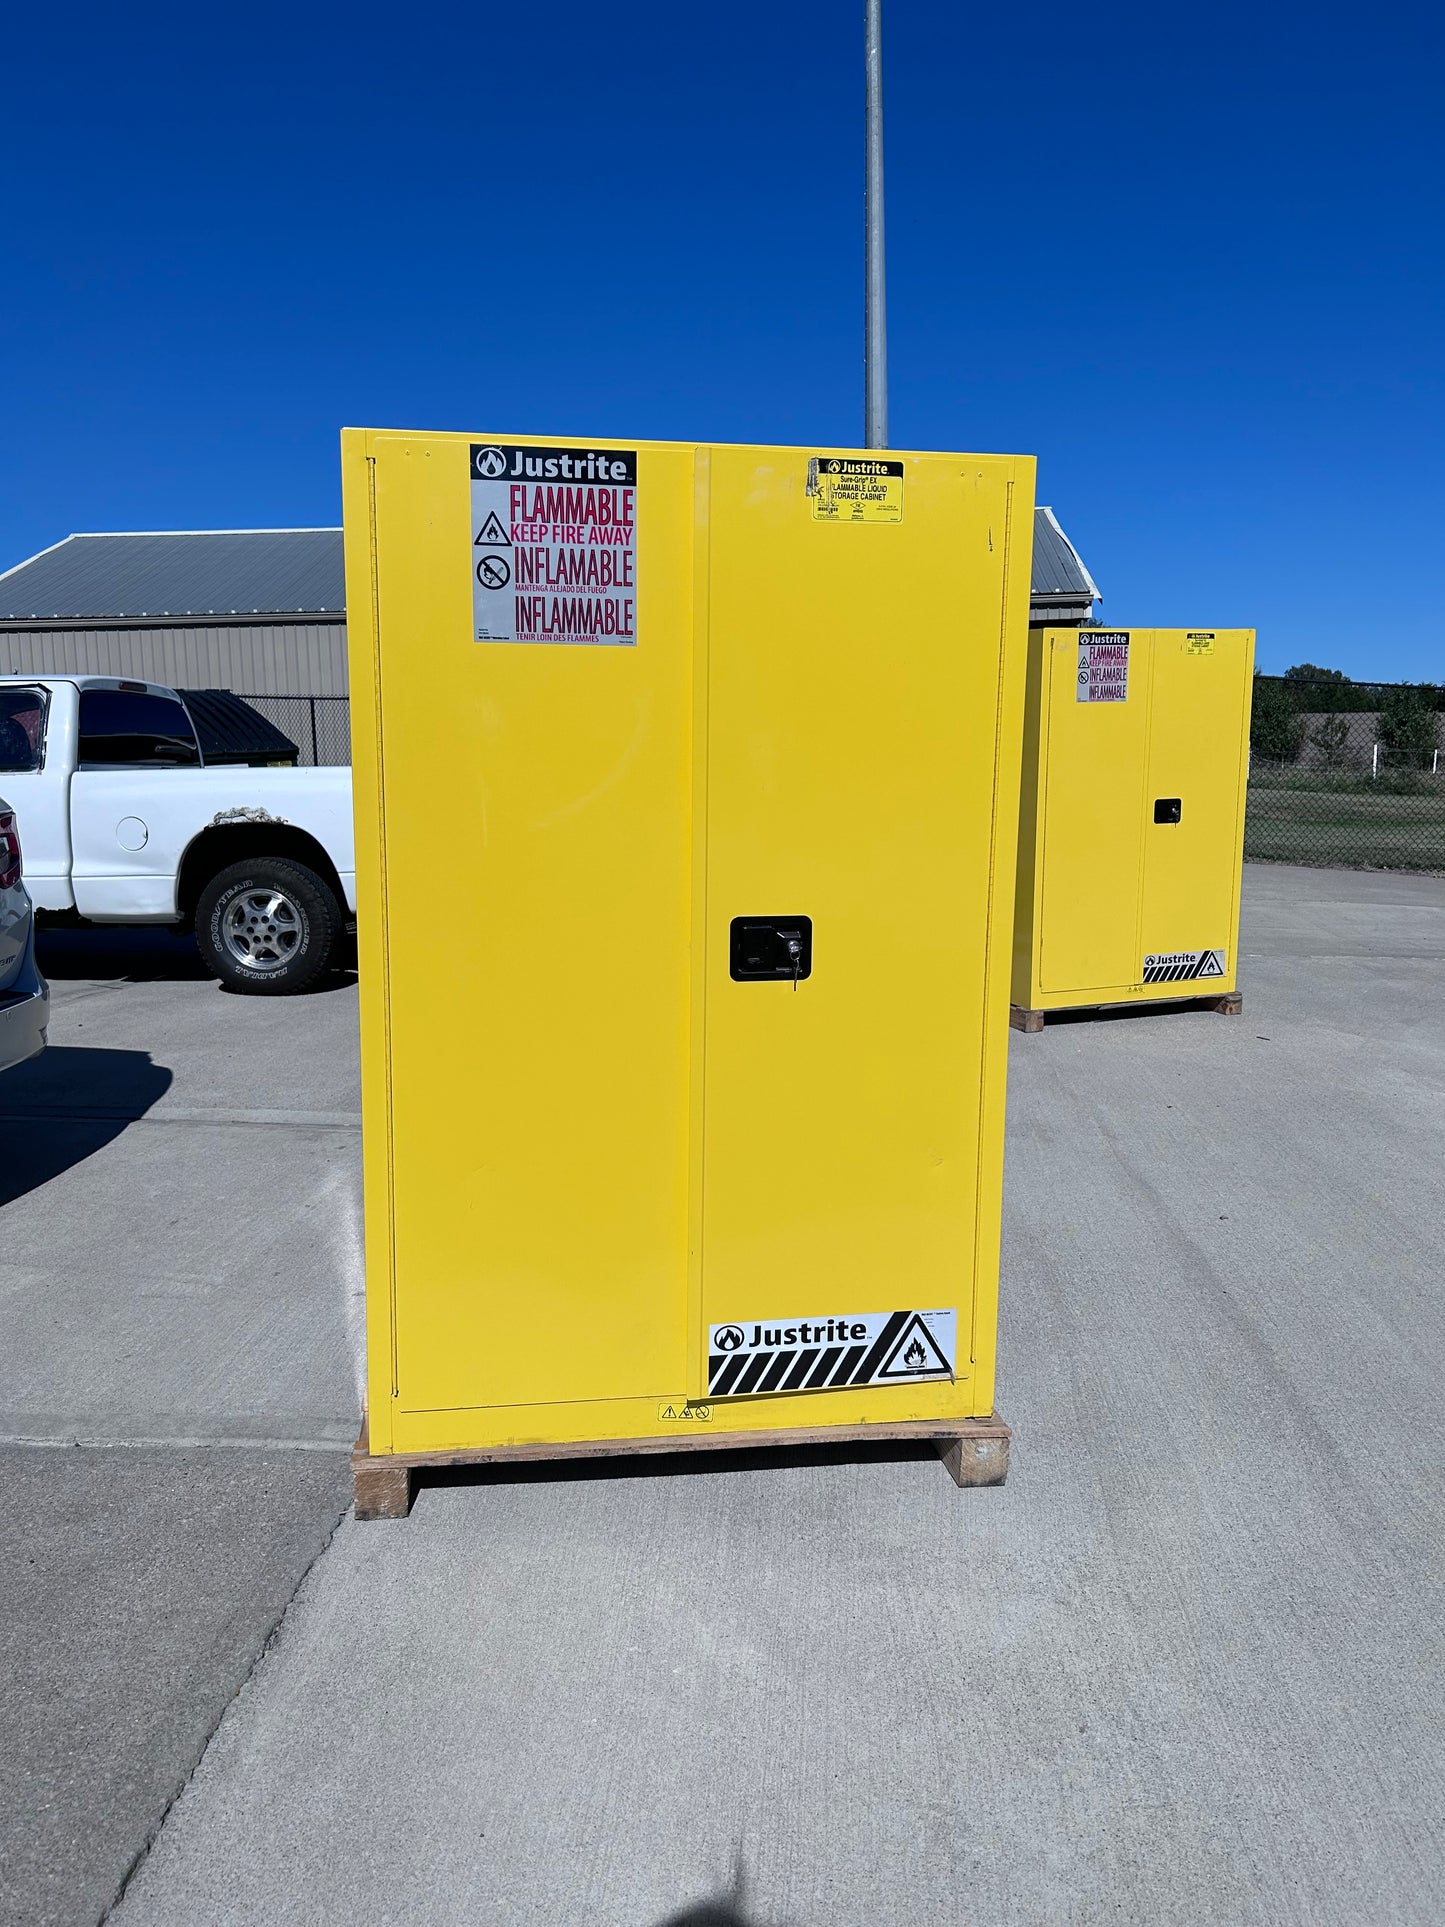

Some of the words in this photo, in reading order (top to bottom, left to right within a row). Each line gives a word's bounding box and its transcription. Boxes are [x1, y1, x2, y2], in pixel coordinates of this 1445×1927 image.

[511, 451, 627, 480] Justrite
[841, 461, 888, 475] Justrite
[867, 485, 888, 493] LIQUID
[860, 493, 886, 501] CABINET
[510, 485, 633, 526] FLAMMABLE
[511, 523, 548, 543] KEEP
[552, 525, 585, 544] FIRE
[588, 526, 632, 546] AWAY
[514, 546, 633, 587] INFLAMABLE
[515, 583, 548, 592] MANTENGA
[549, 585, 575, 593] ALEJADO
[576, 586, 587, 594] DEL
[587, 586, 607, 594] FUEGO
[515, 596, 633, 636] INFLAMMABLE
[516, 633, 536, 641] TENIR
[536, 633, 552, 641] LOIN
[553, 634, 566, 642] DES
[567, 634, 599, 642] FLAMMES
[1090, 634, 1127, 644] Justrite
[1089, 646, 1128, 660] FLAMMABLE
[1089, 668, 1127, 681] INFLAMABLE
[1089, 685, 1126, 699] INFLAMMABLE
[211, 880, 253, 952] GOODYEAR
[1156, 954, 1196, 965] Justrite
[235, 965, 288, 980] RADIAL
[749, 1319, 867, 1348] Justrite
